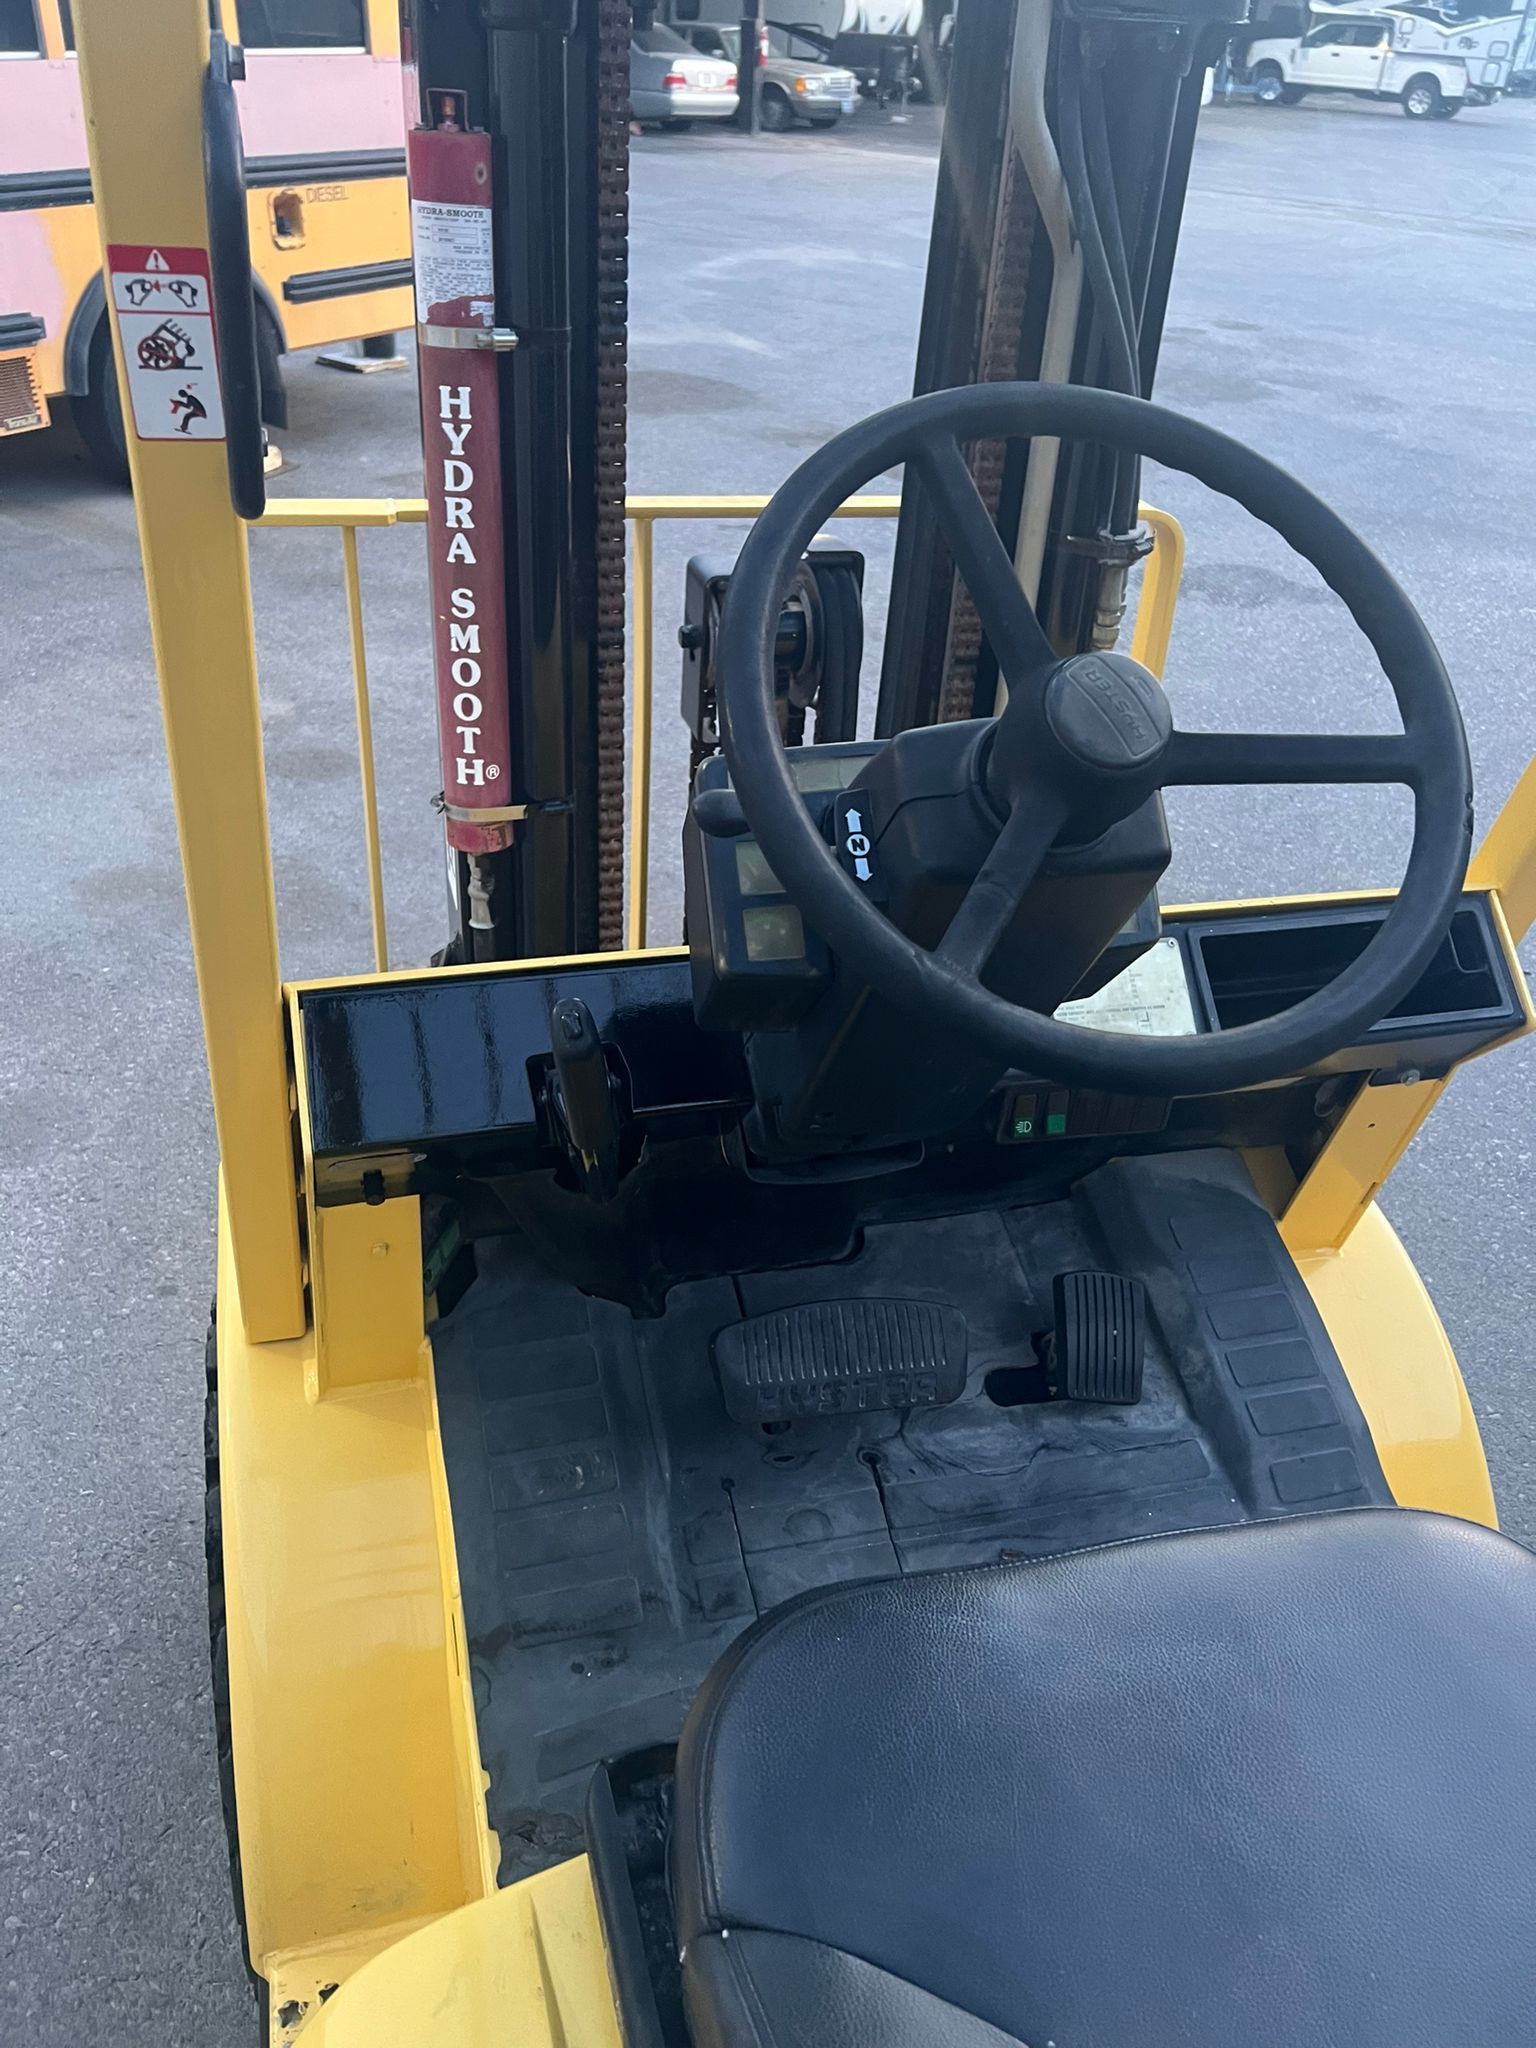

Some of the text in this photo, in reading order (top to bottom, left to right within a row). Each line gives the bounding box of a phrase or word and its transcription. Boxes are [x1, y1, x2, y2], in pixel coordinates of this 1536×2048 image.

[306, 185, 349, 203] DIESEL
[439, 385, 477, 564] HYDRA
[1085, 669, 1146, 739] HYSTER
[850, 838, 866, 852] N
